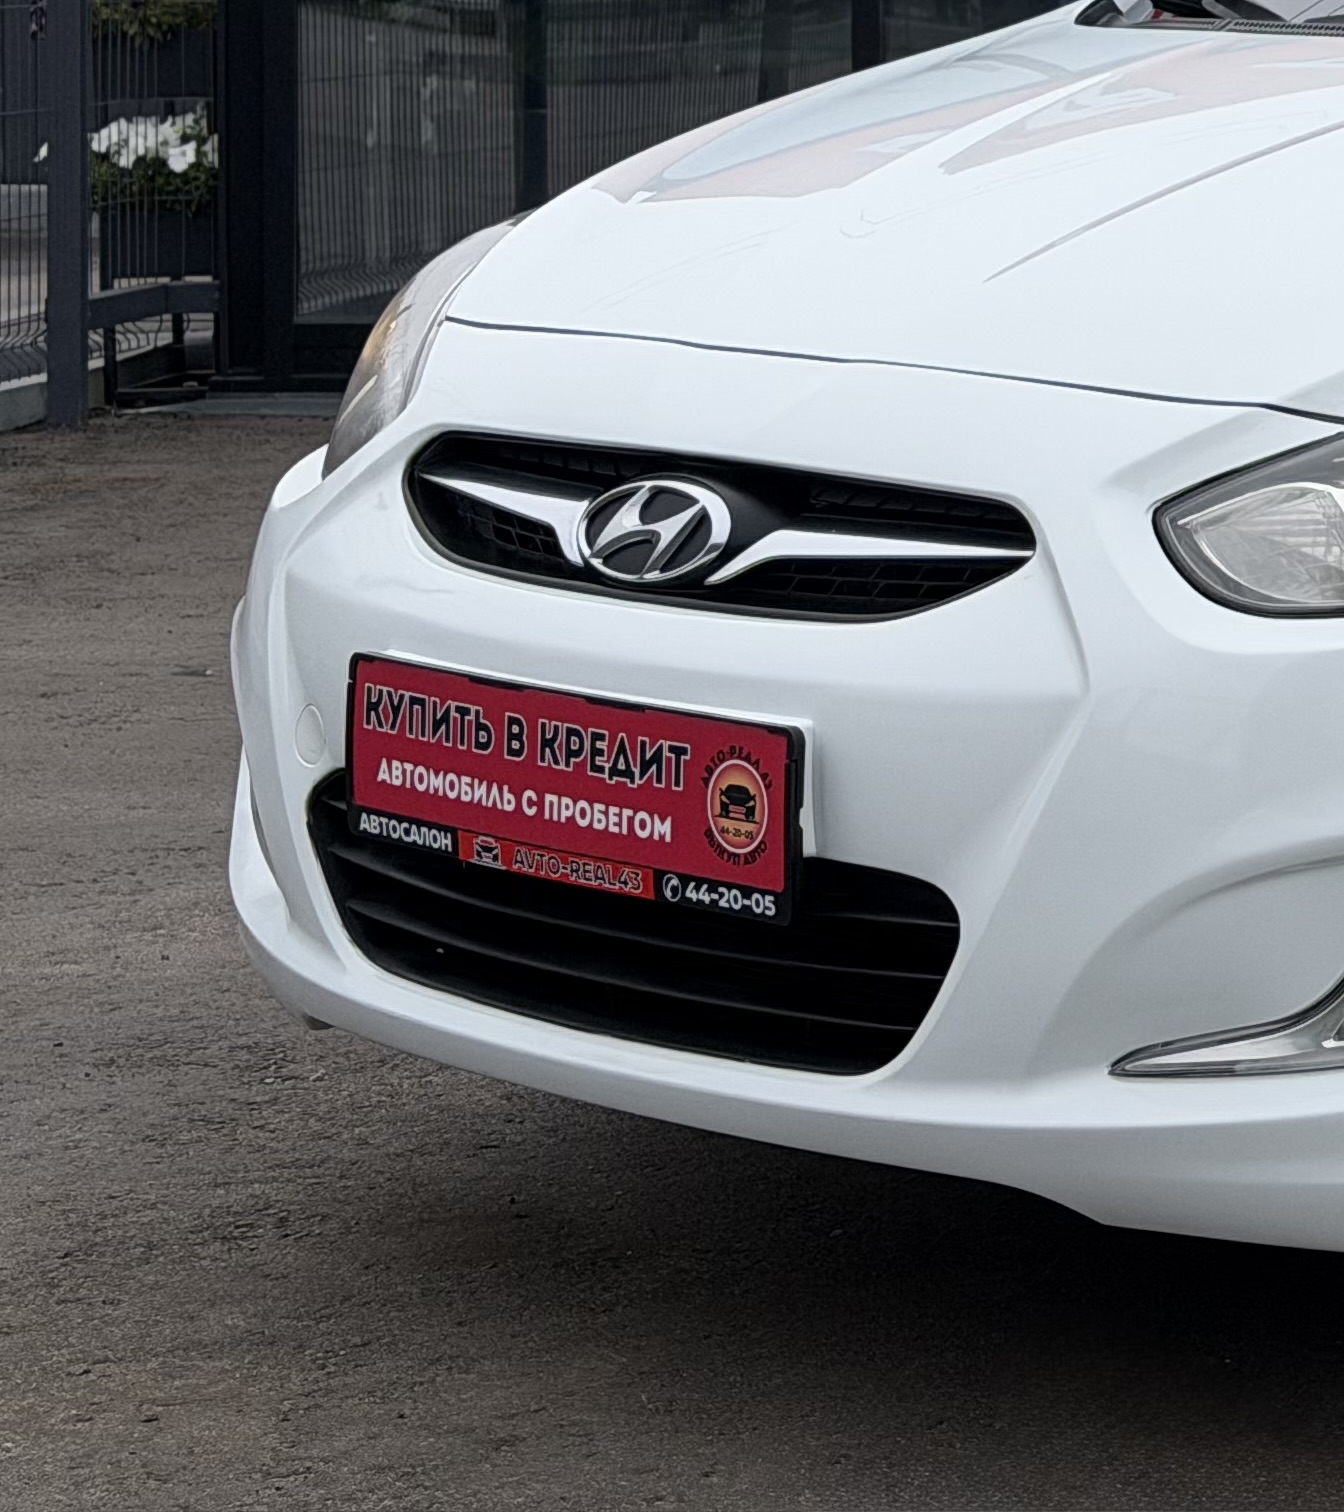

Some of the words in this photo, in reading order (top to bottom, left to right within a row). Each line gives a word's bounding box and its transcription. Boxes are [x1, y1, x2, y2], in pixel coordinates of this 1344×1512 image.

[363, 683, 495, 754] КУПИТЬ
[503, 711, 528, 760] В
[537, 719, 692, 791] КРЕДИТ
[376, 757, 516, 813] АВТОМОБИЛЬ
[521, 792, 539, 817] С
[543, 797, 672, 843] ПРОБЕГОМ
[359, 812, 453, 852] АВТОСАЛОН
[511, 845, 645, 894] AVTO-REAL43
[684, 885, 777, 918] 44-20-05
